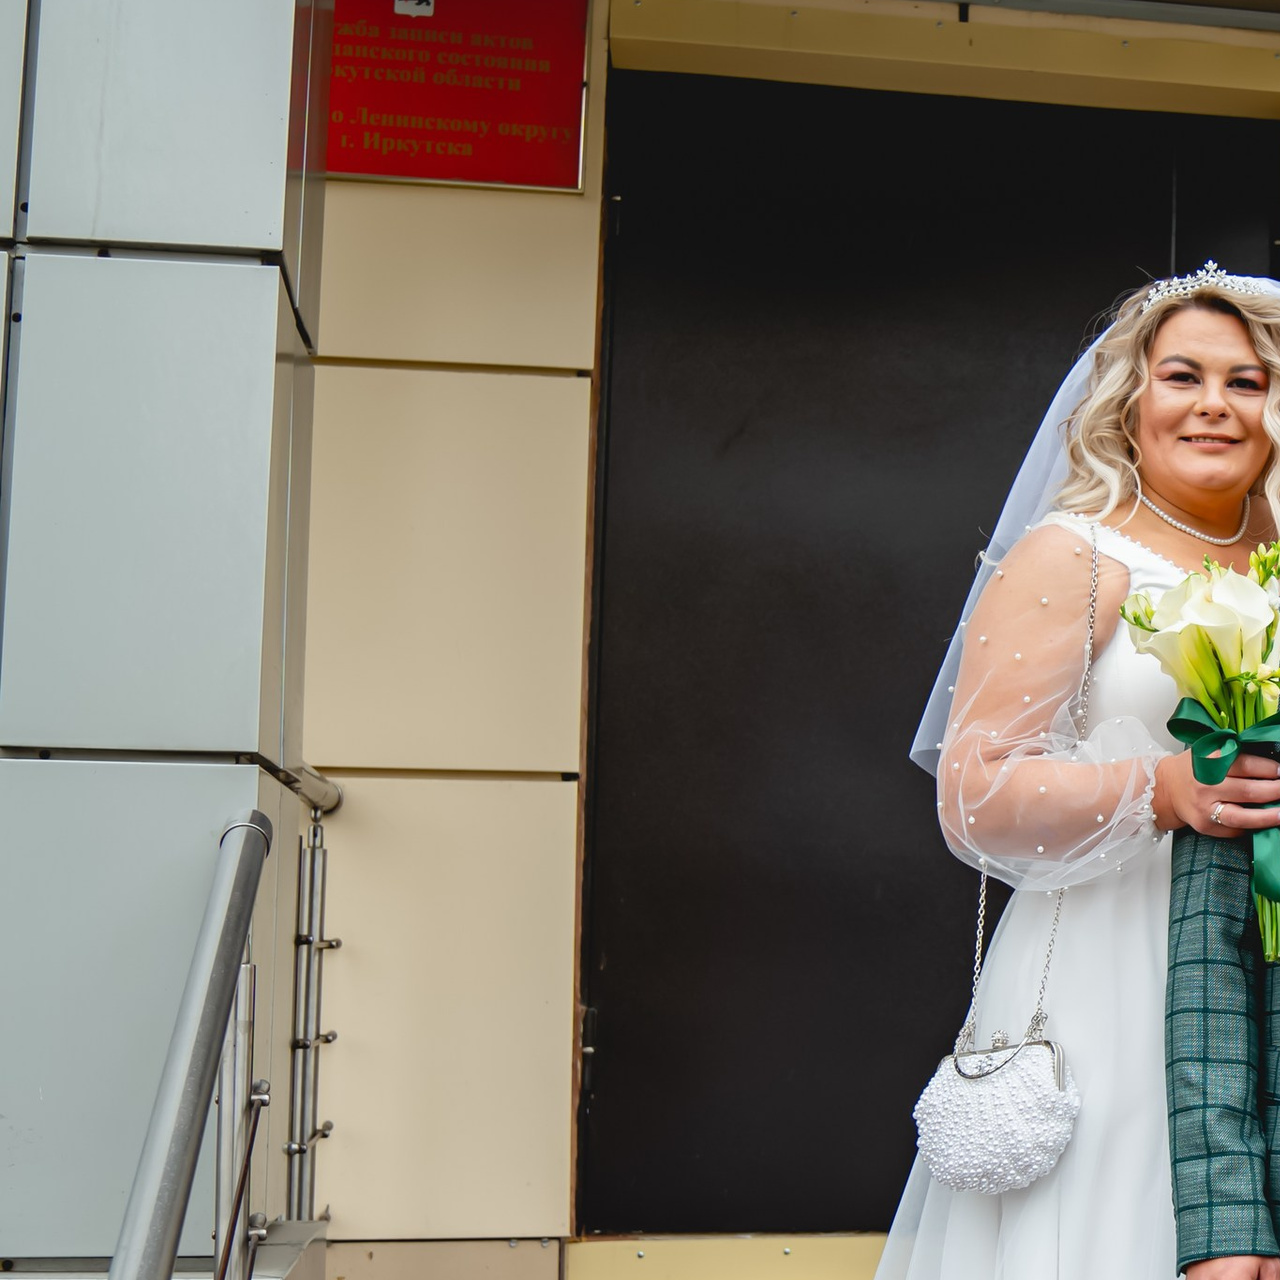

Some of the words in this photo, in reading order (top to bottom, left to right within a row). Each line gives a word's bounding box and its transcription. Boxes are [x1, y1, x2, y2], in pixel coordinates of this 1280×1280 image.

[334, 20, 380, 38] жба
[470, 32, 534, 51] актов
[334, 42, 431, 64] анского
[437, 51, 551, 74] состояния
[331, 62, 425, 84] кутской
[432, 70, 521, 92] области
[350, 107, 490, 138] Ленинскому
[498, 122, 575, 144] округу
[363, 131, 473, 157] Иркутска
